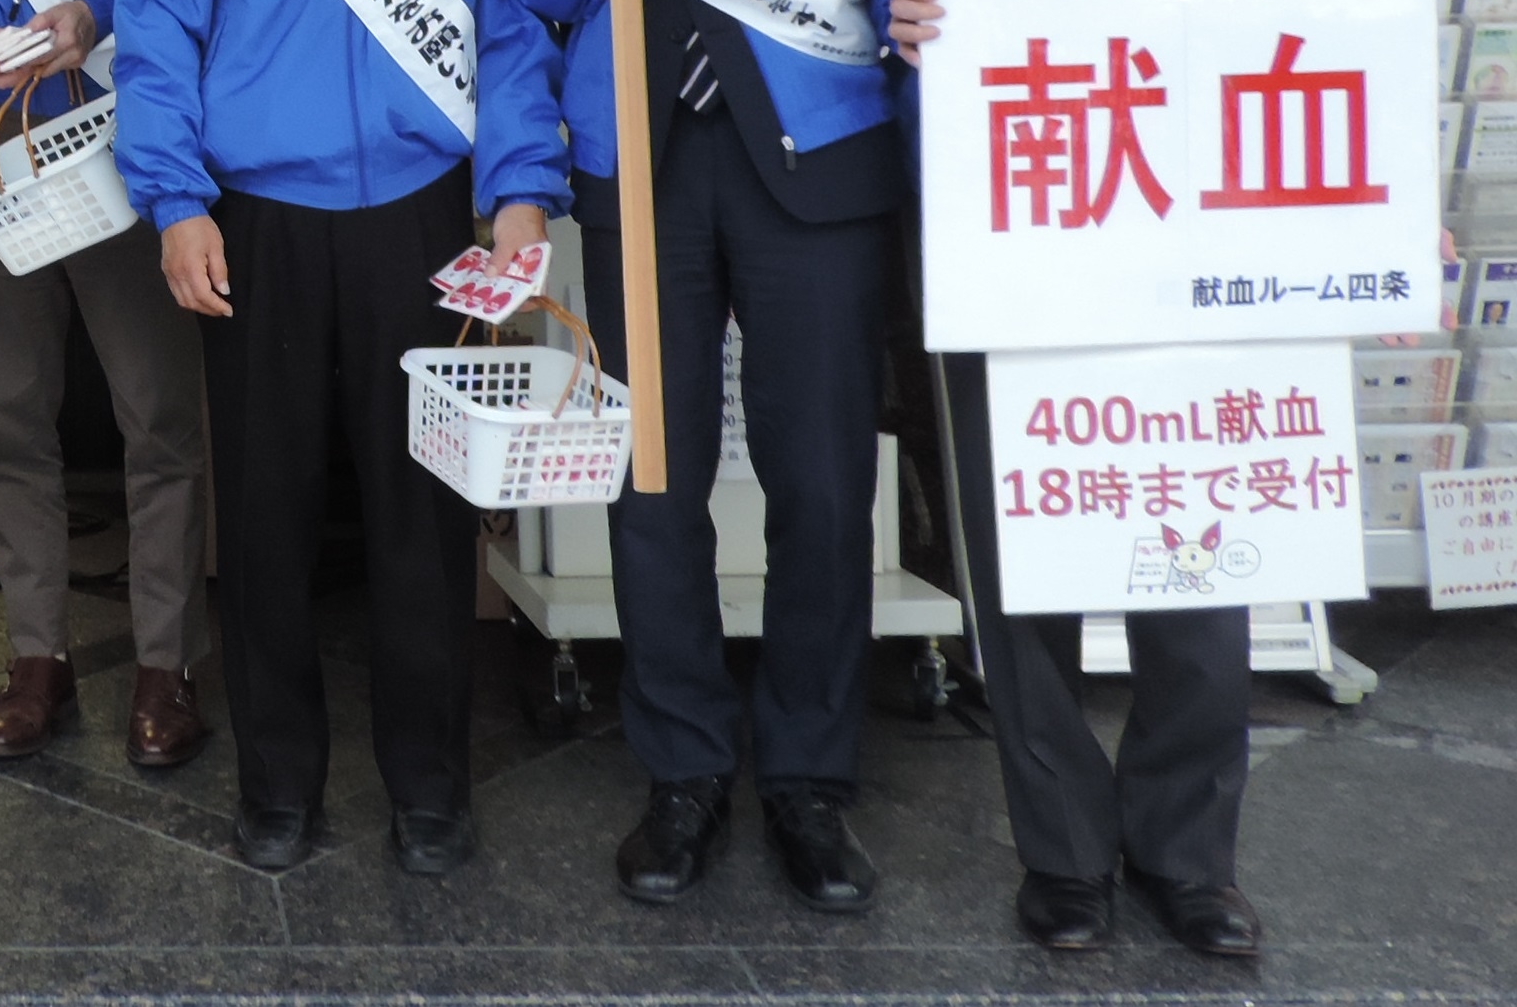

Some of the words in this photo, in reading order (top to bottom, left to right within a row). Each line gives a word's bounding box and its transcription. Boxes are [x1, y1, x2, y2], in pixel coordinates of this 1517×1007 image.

[980, 32, 1389, 233] 献血
[1192, 270, 1411, 308] 献血ルーム四条
[1026, 385, 1326, 446] 400mL献血
[1002, 454, 1353, 520] 18時まで受付
